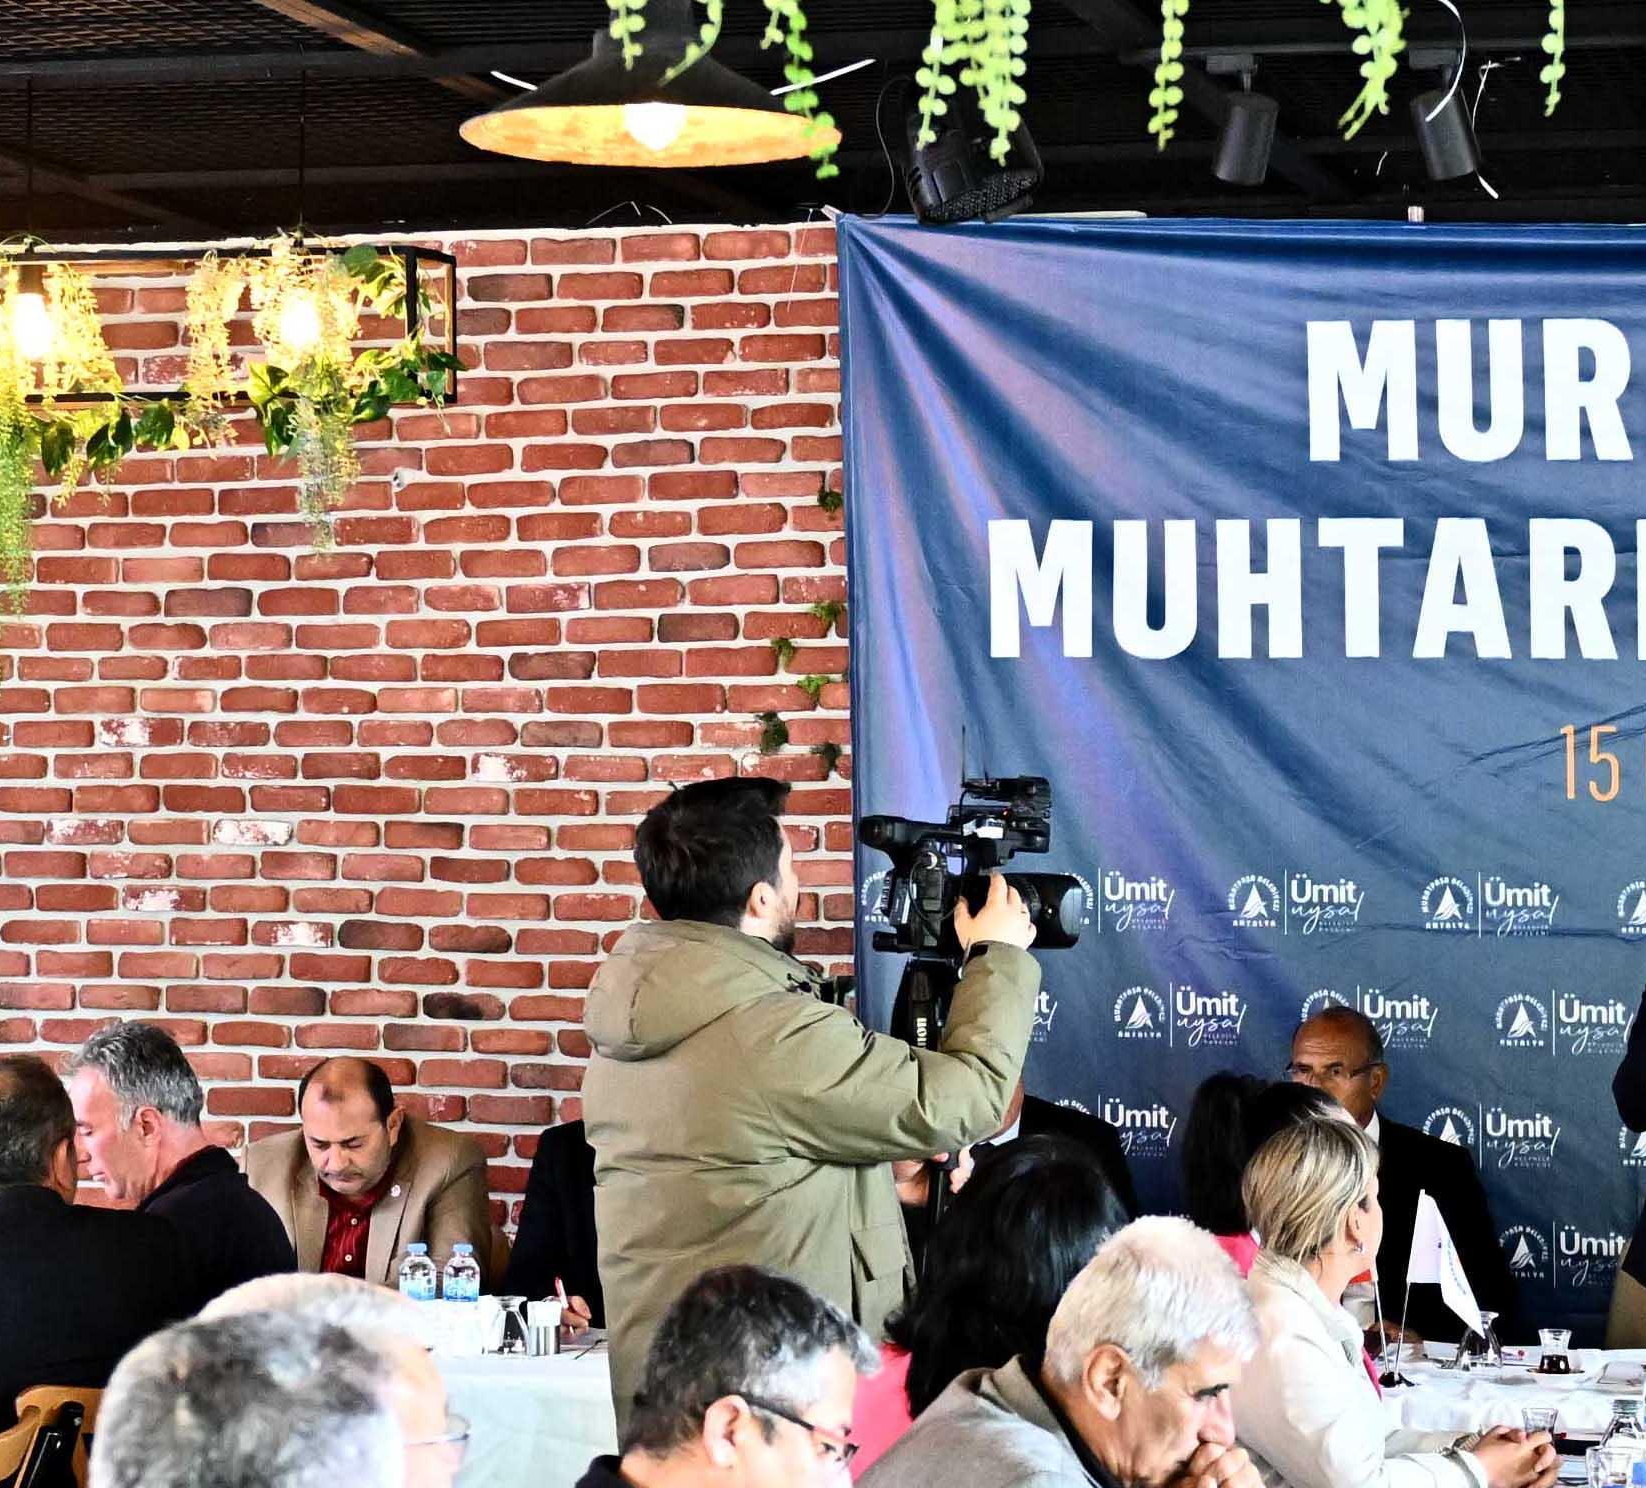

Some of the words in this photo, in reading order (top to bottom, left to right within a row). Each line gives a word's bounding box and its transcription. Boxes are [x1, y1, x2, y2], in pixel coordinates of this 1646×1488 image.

[1560, 724, 1621, 802] 15
[1104, 871, 1168, 902] Ümit
[1291, 873, 1357, 904] Ümit
[1484, 876, 1552, 907] Ümit
[1176, 986, 1239, 1016] Ümit
[1364, 988, 1430, 1019] Ümit
[1559, 993, 1626, 1024] Ümit
[1372, 1007, 1438, 1048] ysal
[1104, 1098, 1169, 1128] Ümit
[1486, 1107, 1553, 1138] Ümit
[1560, 1225, 1626, 1256] Ümit
